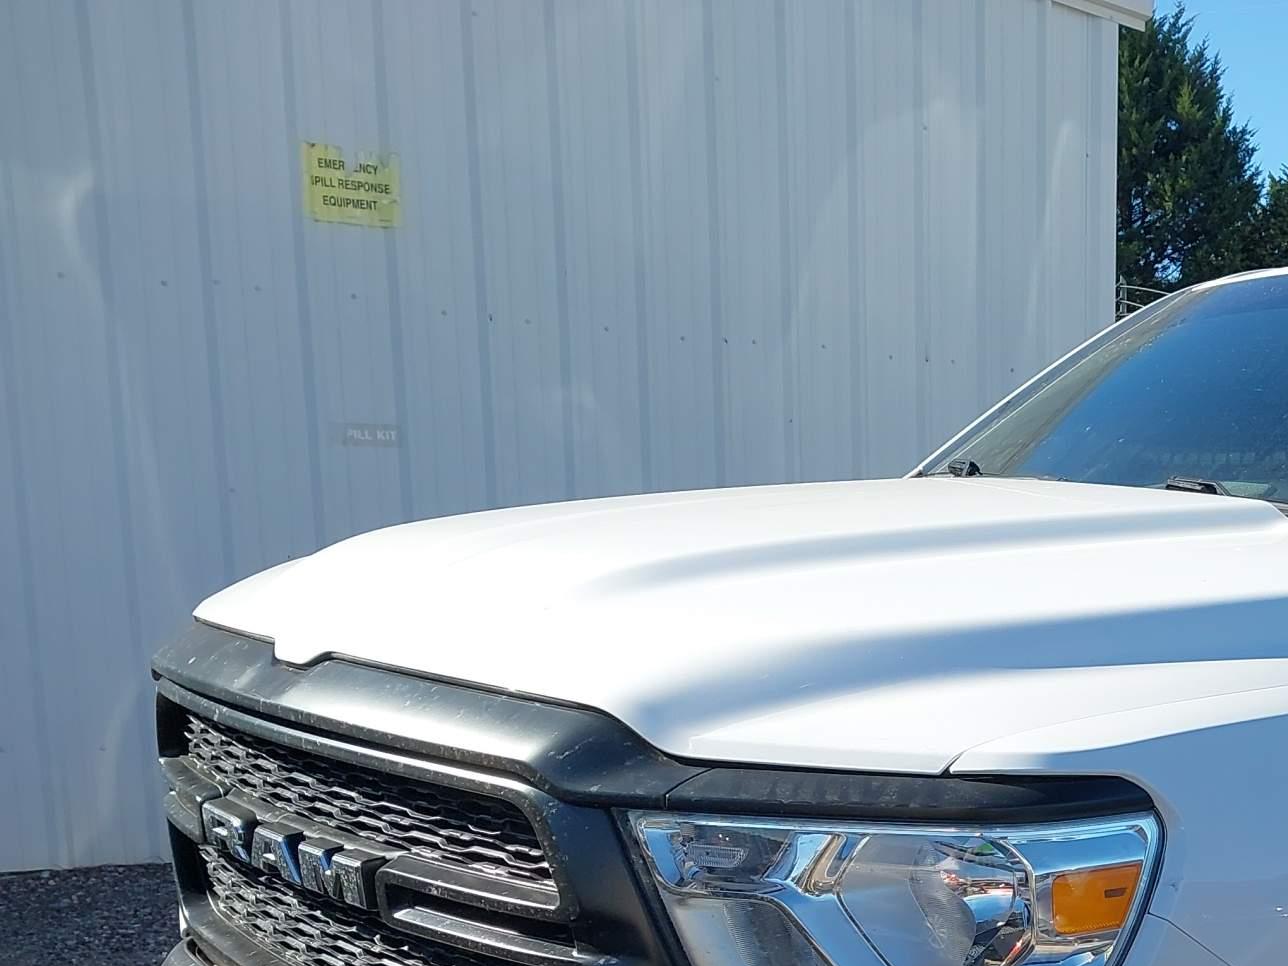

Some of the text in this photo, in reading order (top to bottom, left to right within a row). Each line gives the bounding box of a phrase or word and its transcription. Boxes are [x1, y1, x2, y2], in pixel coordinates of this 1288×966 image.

[317, 157, 378, 175] EMERNCY
[337, 178, 391, 195] RESPONSE
[322, 195, 378, 211] EQUIPMENT
[201, 798, 378, 911] RAM
